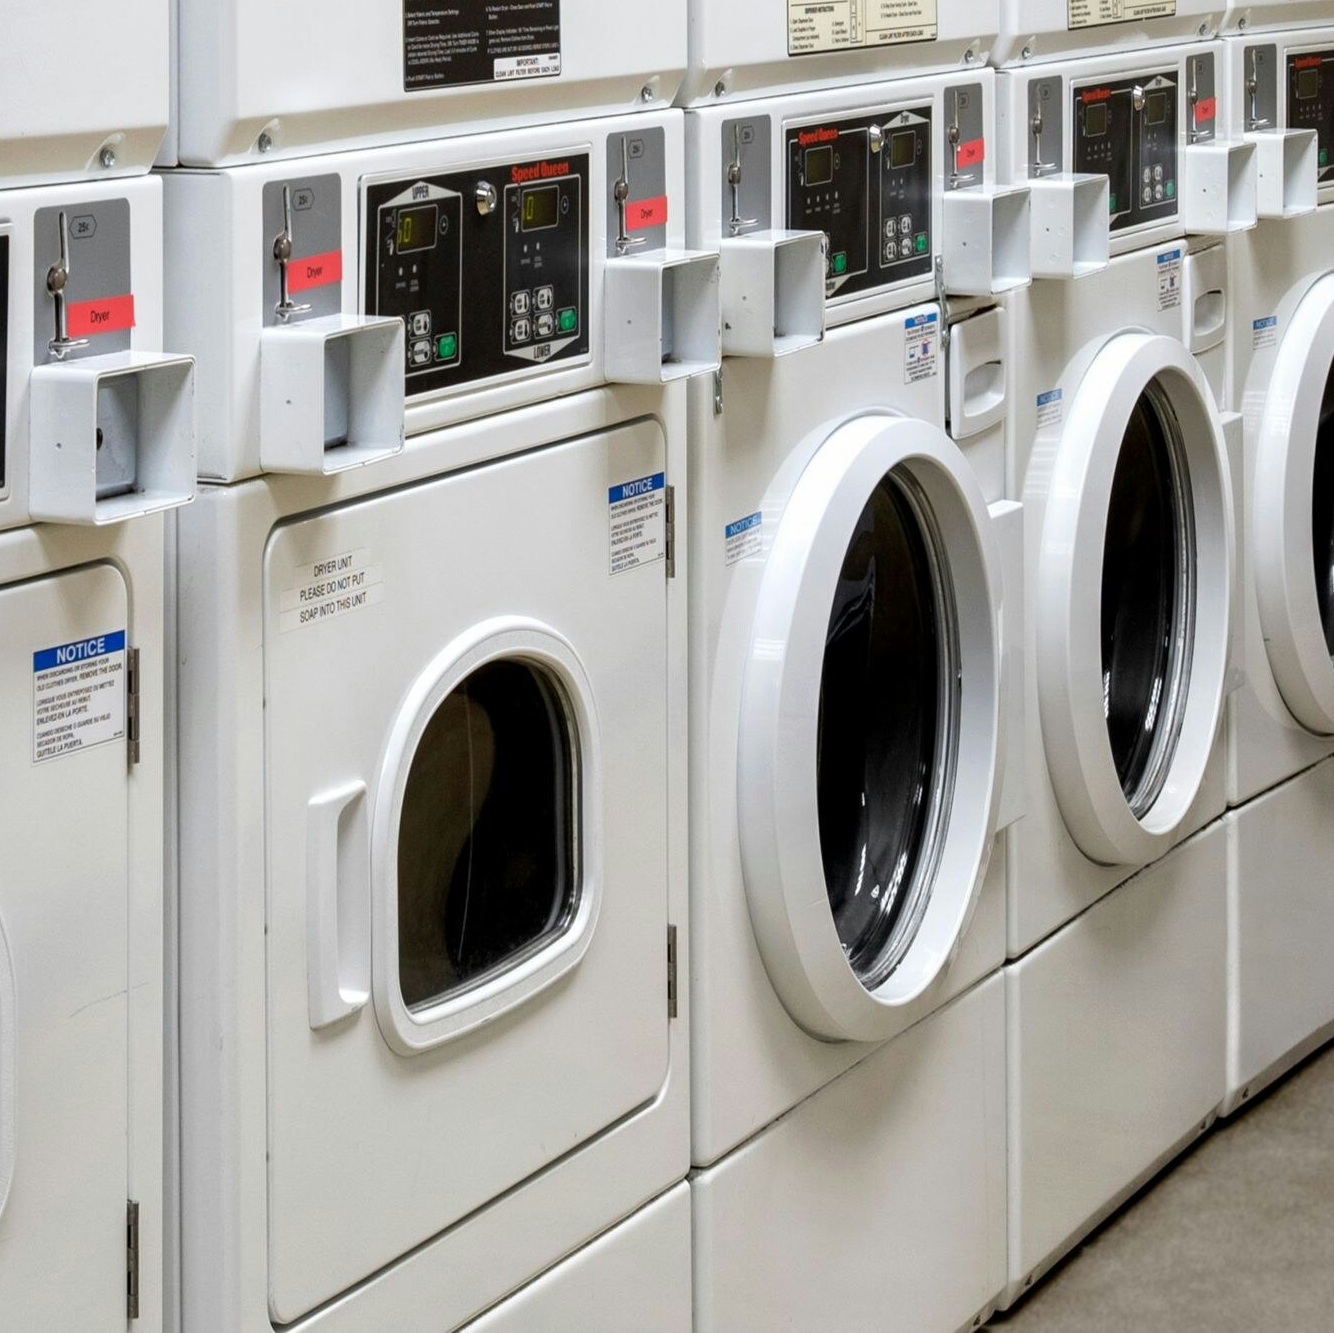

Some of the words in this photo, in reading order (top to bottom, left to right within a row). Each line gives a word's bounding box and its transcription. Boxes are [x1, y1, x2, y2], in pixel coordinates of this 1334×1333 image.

[511, 165, 540, 184] Speed
[541, 162, 569, 177] Queen
[412, 185, 429, 200] UPPER
[307, 266, 323, 278] Dryer
[90, 310, 110, 324] Dryer
[533, 344, 551, 359] LOWER
[622, 477, 652, 498] NOTICE
[314, 560, 336, 577] DRYER
[337, 555, 352, 570] UNIT
[300, 584, 325, 601] PLEASE
[327, 581, 337, 594] DO
[337, 576, 350, 590] NOT
[352, 572, 364, 585] PUT
[300, 607, 318, 623] SOAP
[319, 602, 335, 617] INTO
[336, 597, 350, 611] THIS
[351, 592, 366, 607] UNIT
[57, 636, 105, 664] NOTICE
